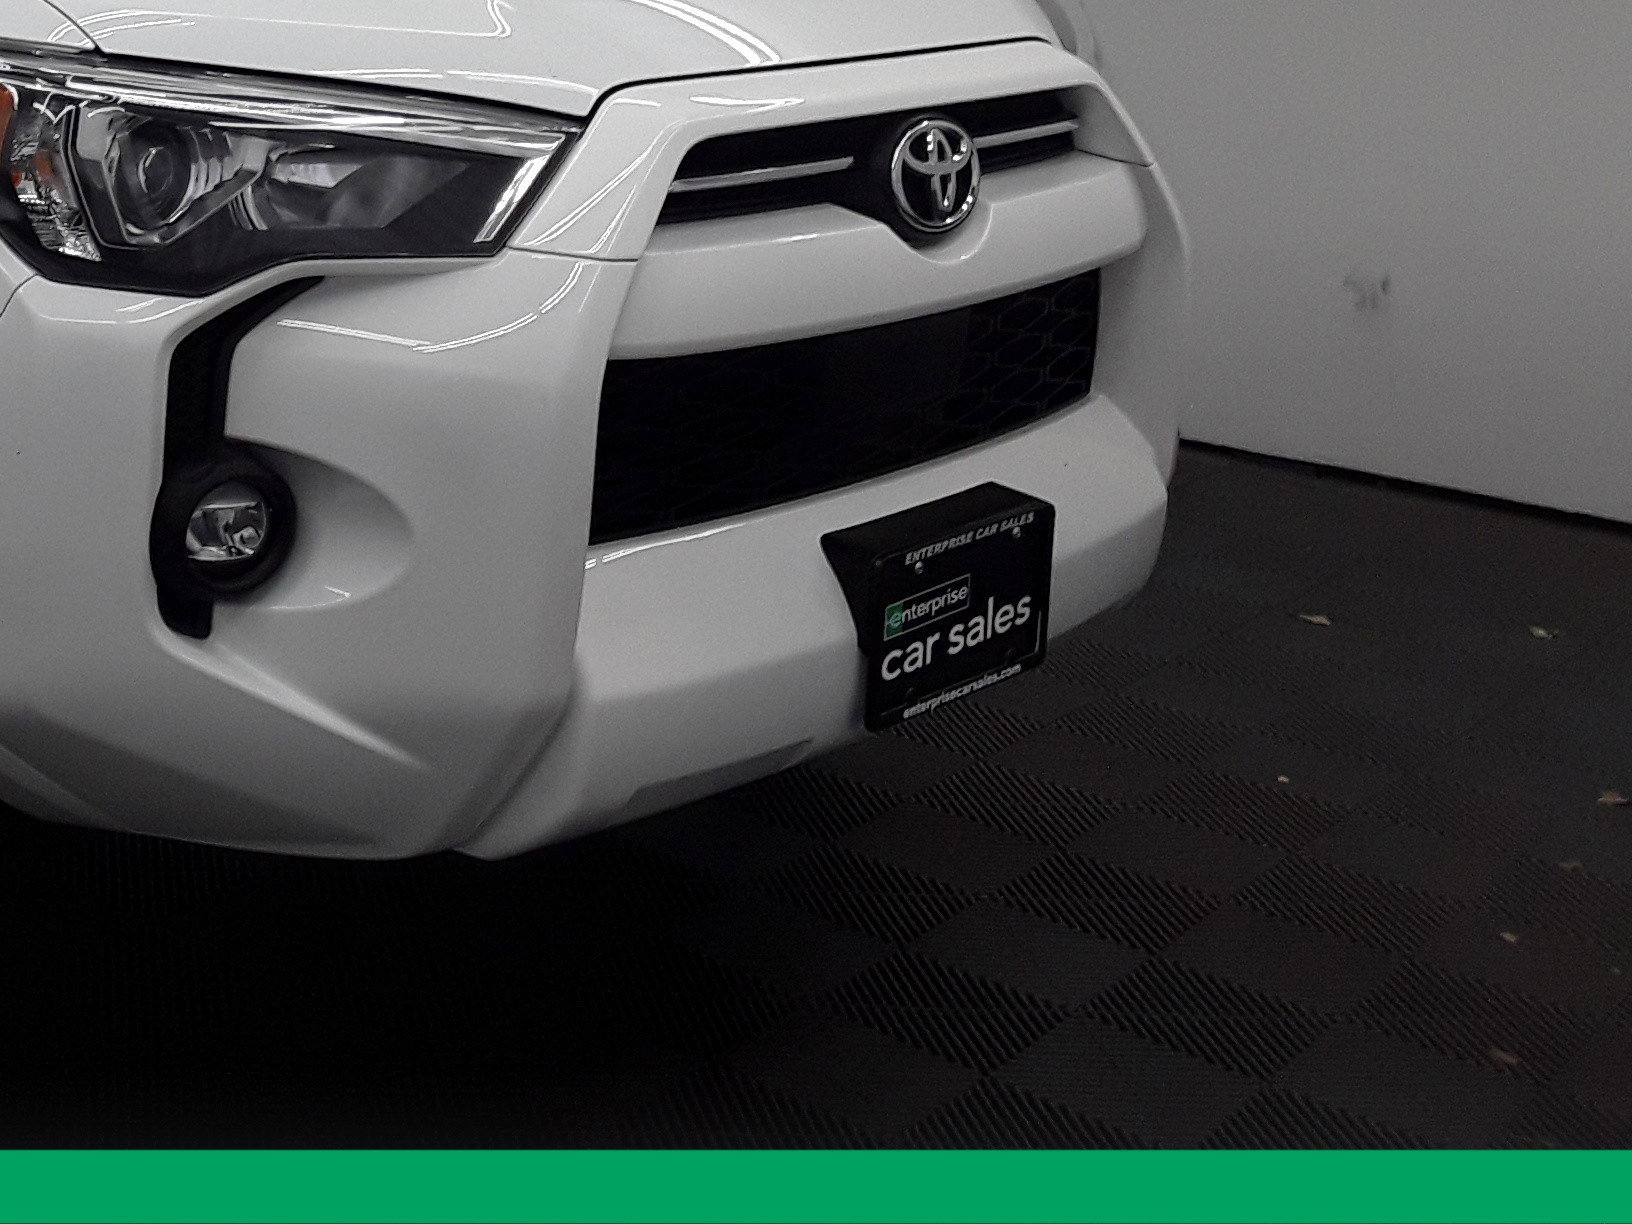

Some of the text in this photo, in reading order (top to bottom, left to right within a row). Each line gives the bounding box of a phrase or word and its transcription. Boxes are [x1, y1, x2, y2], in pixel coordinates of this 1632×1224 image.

[904, 511, 1035, 565] ENTERPRISE CAR SALES
[888, 585, 969, 627] enterprise
[881, 595, 1032, 681] car sales
[903, 664, 1022, 719] enterprisecarsales.com
